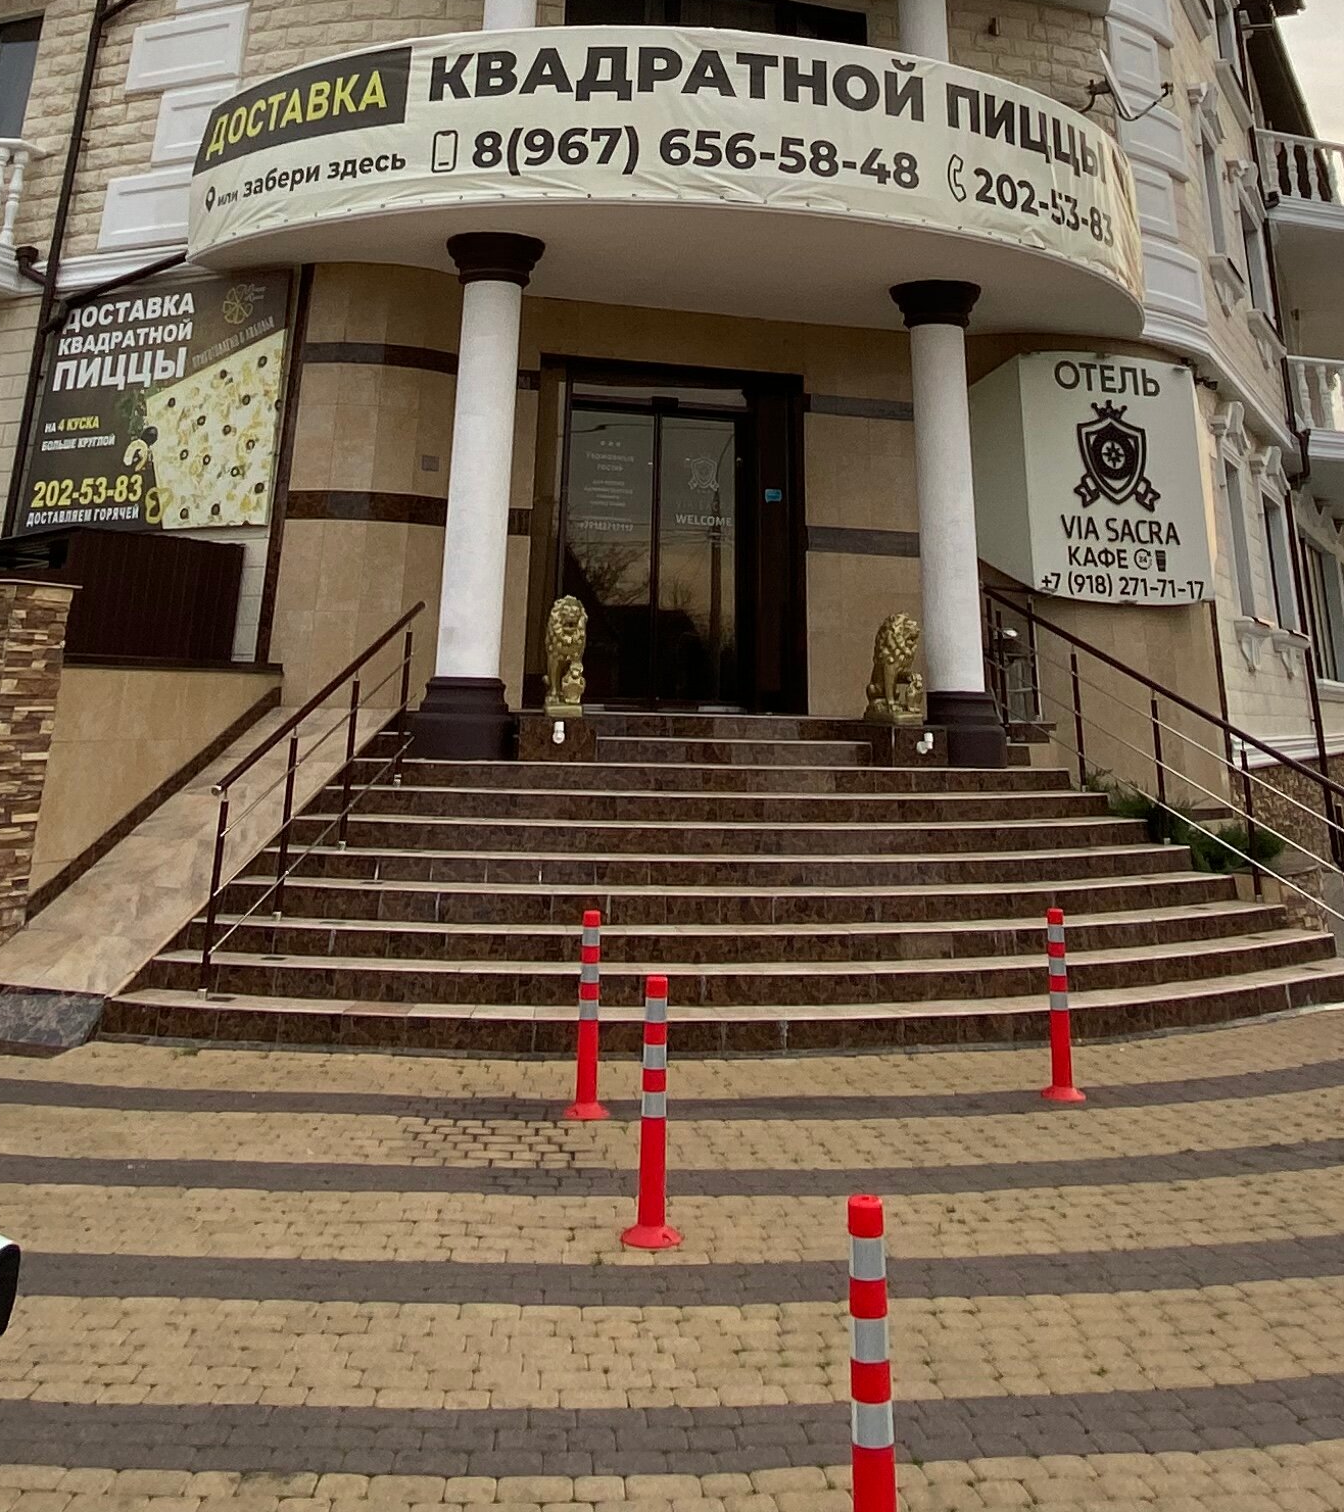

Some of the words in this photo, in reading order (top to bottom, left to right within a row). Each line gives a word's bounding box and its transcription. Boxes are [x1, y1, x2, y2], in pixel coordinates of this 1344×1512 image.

[205, 69, 387, 161] ДОСТАВКА
[428, 46, 924, 122] КВАДРАТНОЙ
[945, 82, 1107, 185] ПИЦЦЫ
[471, 125, 640, 176] 8(967)
[659, 128, 919, 189] 656-58-48
[217, 189, 238, 207] или
[243, 164, 321, 198] забери
[327, 152, 406, 182] здесь
[974, 167, 1114, 248] 202-53-83
[62, 292, 195, 335] ДОСТАВКА
[57, 318, 193, 356] КВАДРАТНОЙ
[52, 346, 187, 392] ПИЦЦЫ
[1054, 360, 1161, 397] ОТЕЛЬ
[41, 437, 77, 451] БОЛЬШЕ
[77, 433, 116, 449] КРУГЛОЙ
[44, 422, 56, 433] НА
[58, 418, 65, 431] 4
[66, 415, 100, 431] КУСКА
[31, 473, 143, 508] 202-53-83
[26, 508, 92, 528] ДОСТАВЛЯЕМ
[93, 504, 140, 522] ГОРЯЧЕЙ
[675, 513, 733, 527] WELCOME
[1060, 514, 1099, 541] VIA
[1106, 518, 1181, 546] SACRA
[1067, 545, 1129, 569] КАФЕ
[1041, 572, 1061, 589] +7
[1067, 571, 1113, 597] (918)
[1119, 576, 1204, 600] 271-71-17
